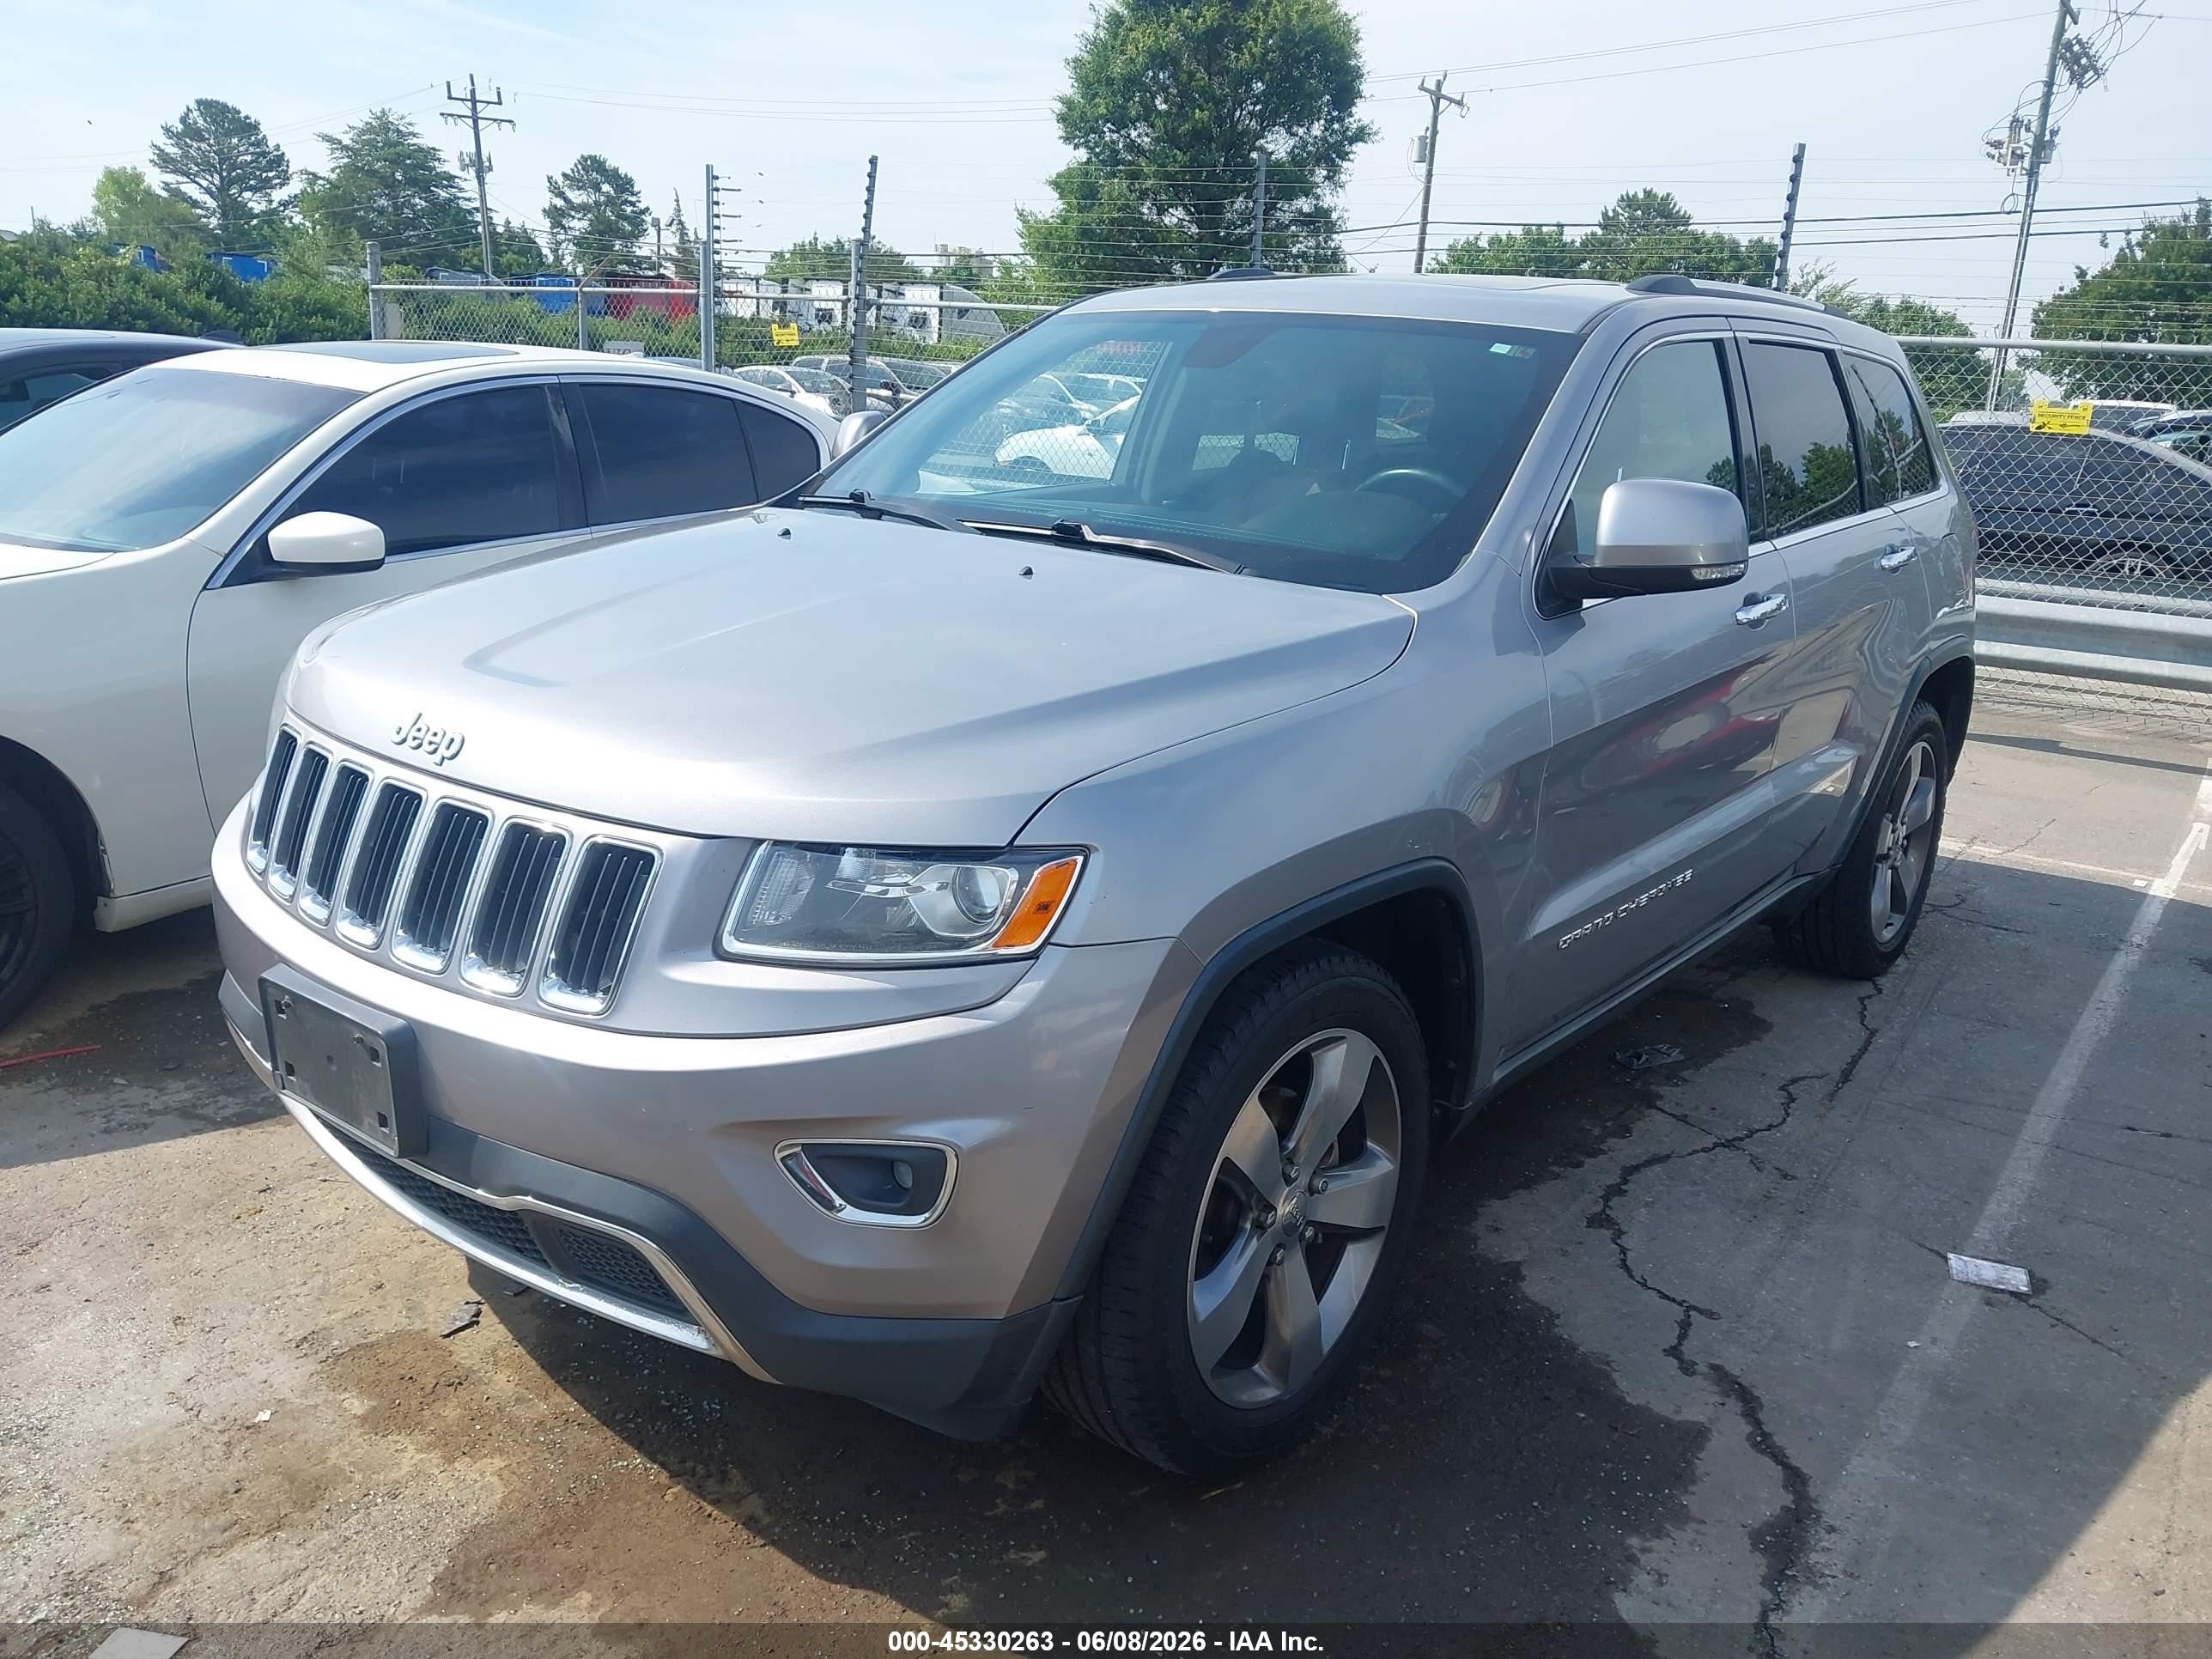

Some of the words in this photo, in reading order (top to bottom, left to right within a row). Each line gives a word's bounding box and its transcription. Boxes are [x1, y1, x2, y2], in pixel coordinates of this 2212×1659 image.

[390, 711, 465, 767] Jeep
[1559, 911, 1614, 950] GRAND
[1617, 867, 1694, 919] CHEROKEE
